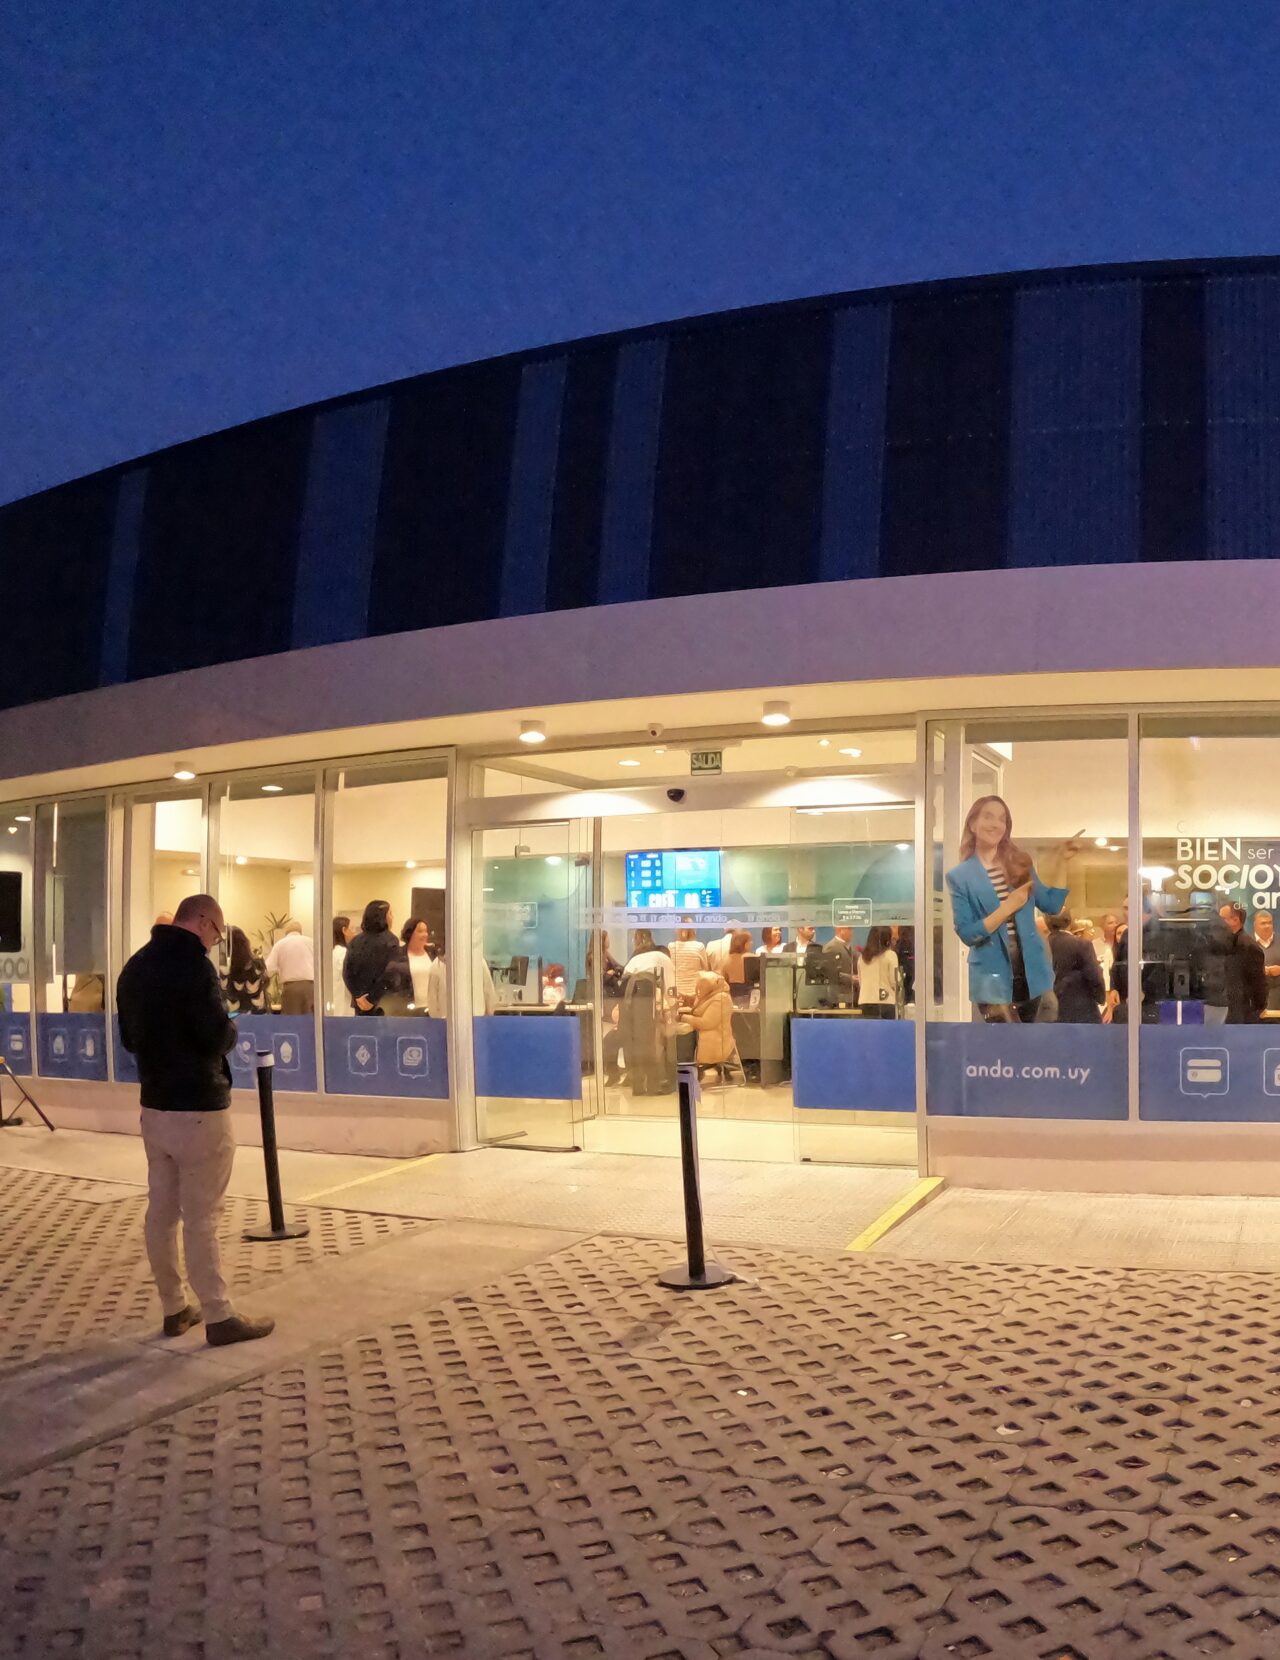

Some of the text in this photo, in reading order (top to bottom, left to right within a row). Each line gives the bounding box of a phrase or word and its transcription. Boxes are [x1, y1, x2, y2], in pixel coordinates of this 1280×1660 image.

[692, 753, 721, 769] SALIDA
[1176, 838, 1274, 861] BIEN ser
[1175, 864, 1275, 890] SOCIO
[966, 1059, 1090, 1085] anda.com.uy
